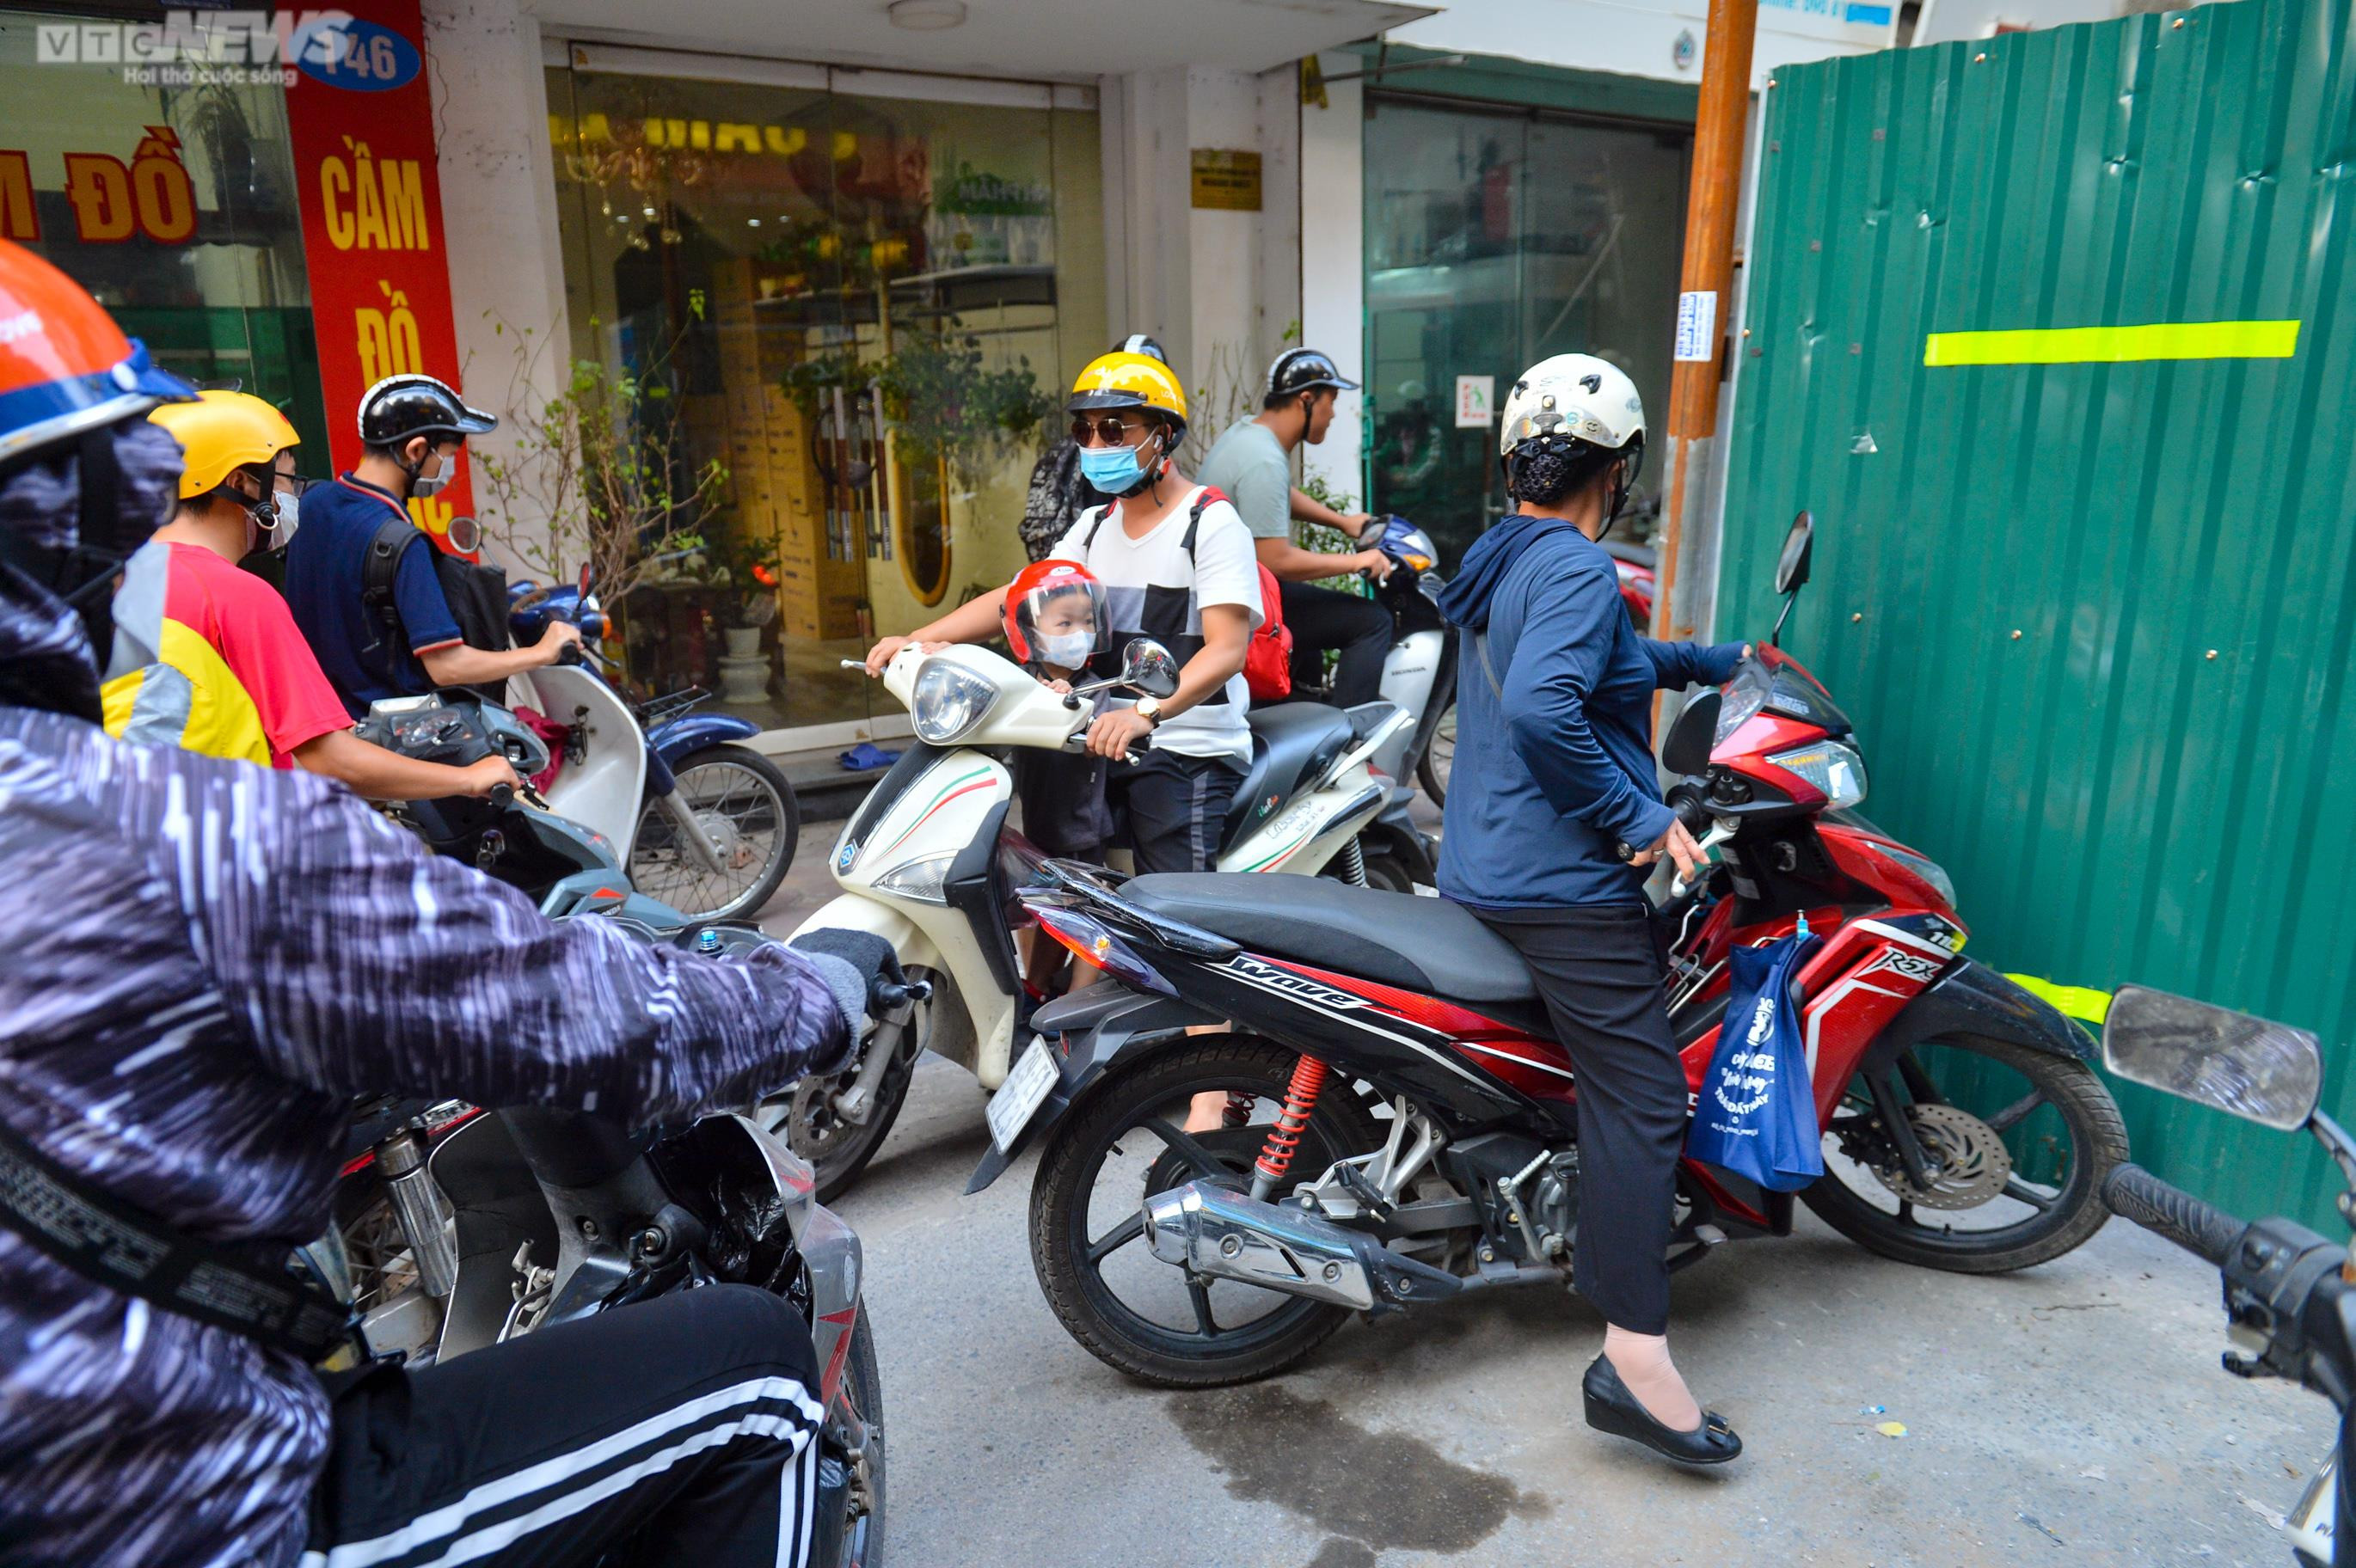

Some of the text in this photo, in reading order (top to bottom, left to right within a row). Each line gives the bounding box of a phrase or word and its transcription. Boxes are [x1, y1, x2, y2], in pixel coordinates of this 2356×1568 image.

[317, 31, 396, 80] 146
[63, 126, 197, 244] ĐỒ
[320, 135, 429, 251] CẦM
